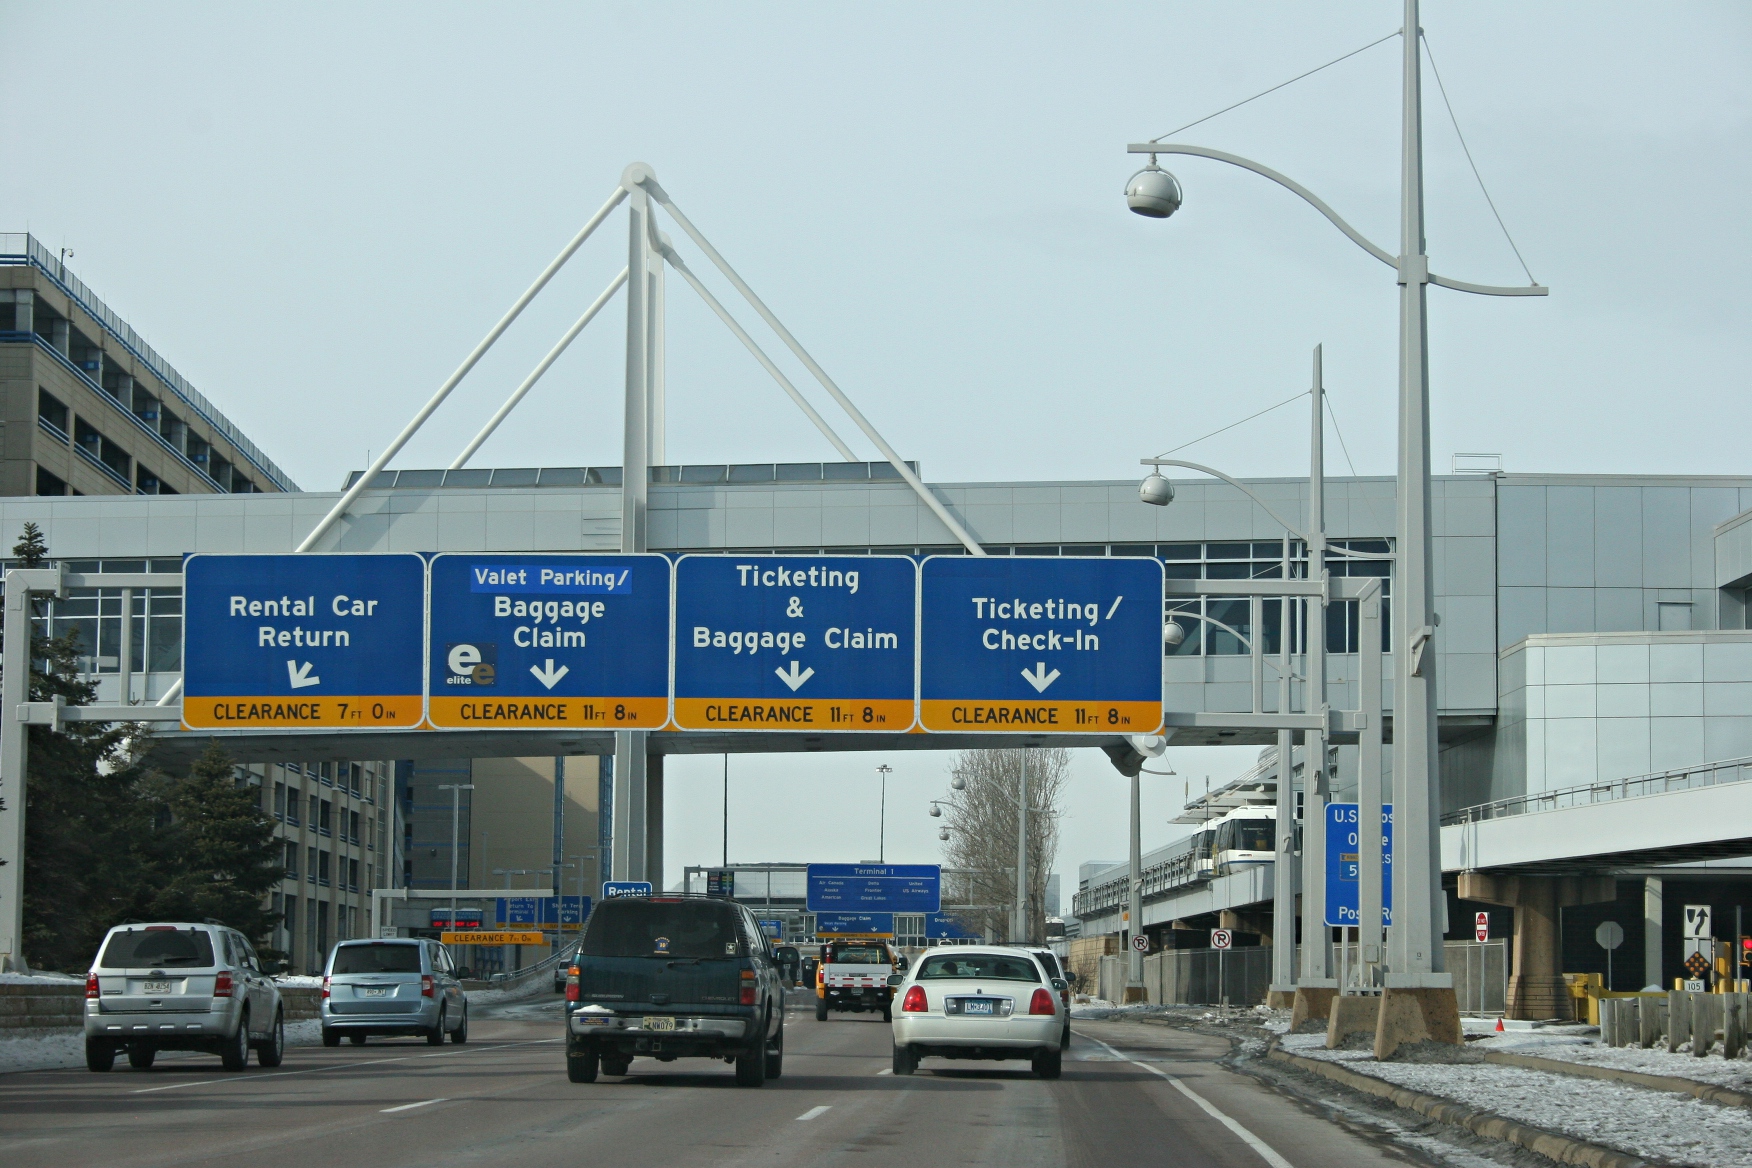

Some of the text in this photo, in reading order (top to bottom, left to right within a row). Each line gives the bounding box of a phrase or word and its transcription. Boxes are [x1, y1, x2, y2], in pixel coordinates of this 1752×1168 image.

[475, 569, 629, 590] Valet Parking/
[737, 565, 859, 594] Ticketing
[231, 595, 378, 617] Rental Car
[494, 597, 604, 624] Baggage
[786, 597, 804, 618] &
[259, 627, 350, 647] Return
[514, 626, 586, 648] Claim
[693, 627, 898, 655] Baggage Claim
[982, 629, 1099, 651] Check-In
[447, 675, 472, 685] elite
[214, 703, 321, 721] CLEARANCE
[460, 704, 567, 721] CLEARANCE
[706, 705, 813, 723] CLEARANCE
[952, 707, 1058, 725] CLEARANCE
[608, 886, 648, 897] Rental
[454, 934, 504, 942] CLEARANCE
[1688, 983, 1701, 991] 105
